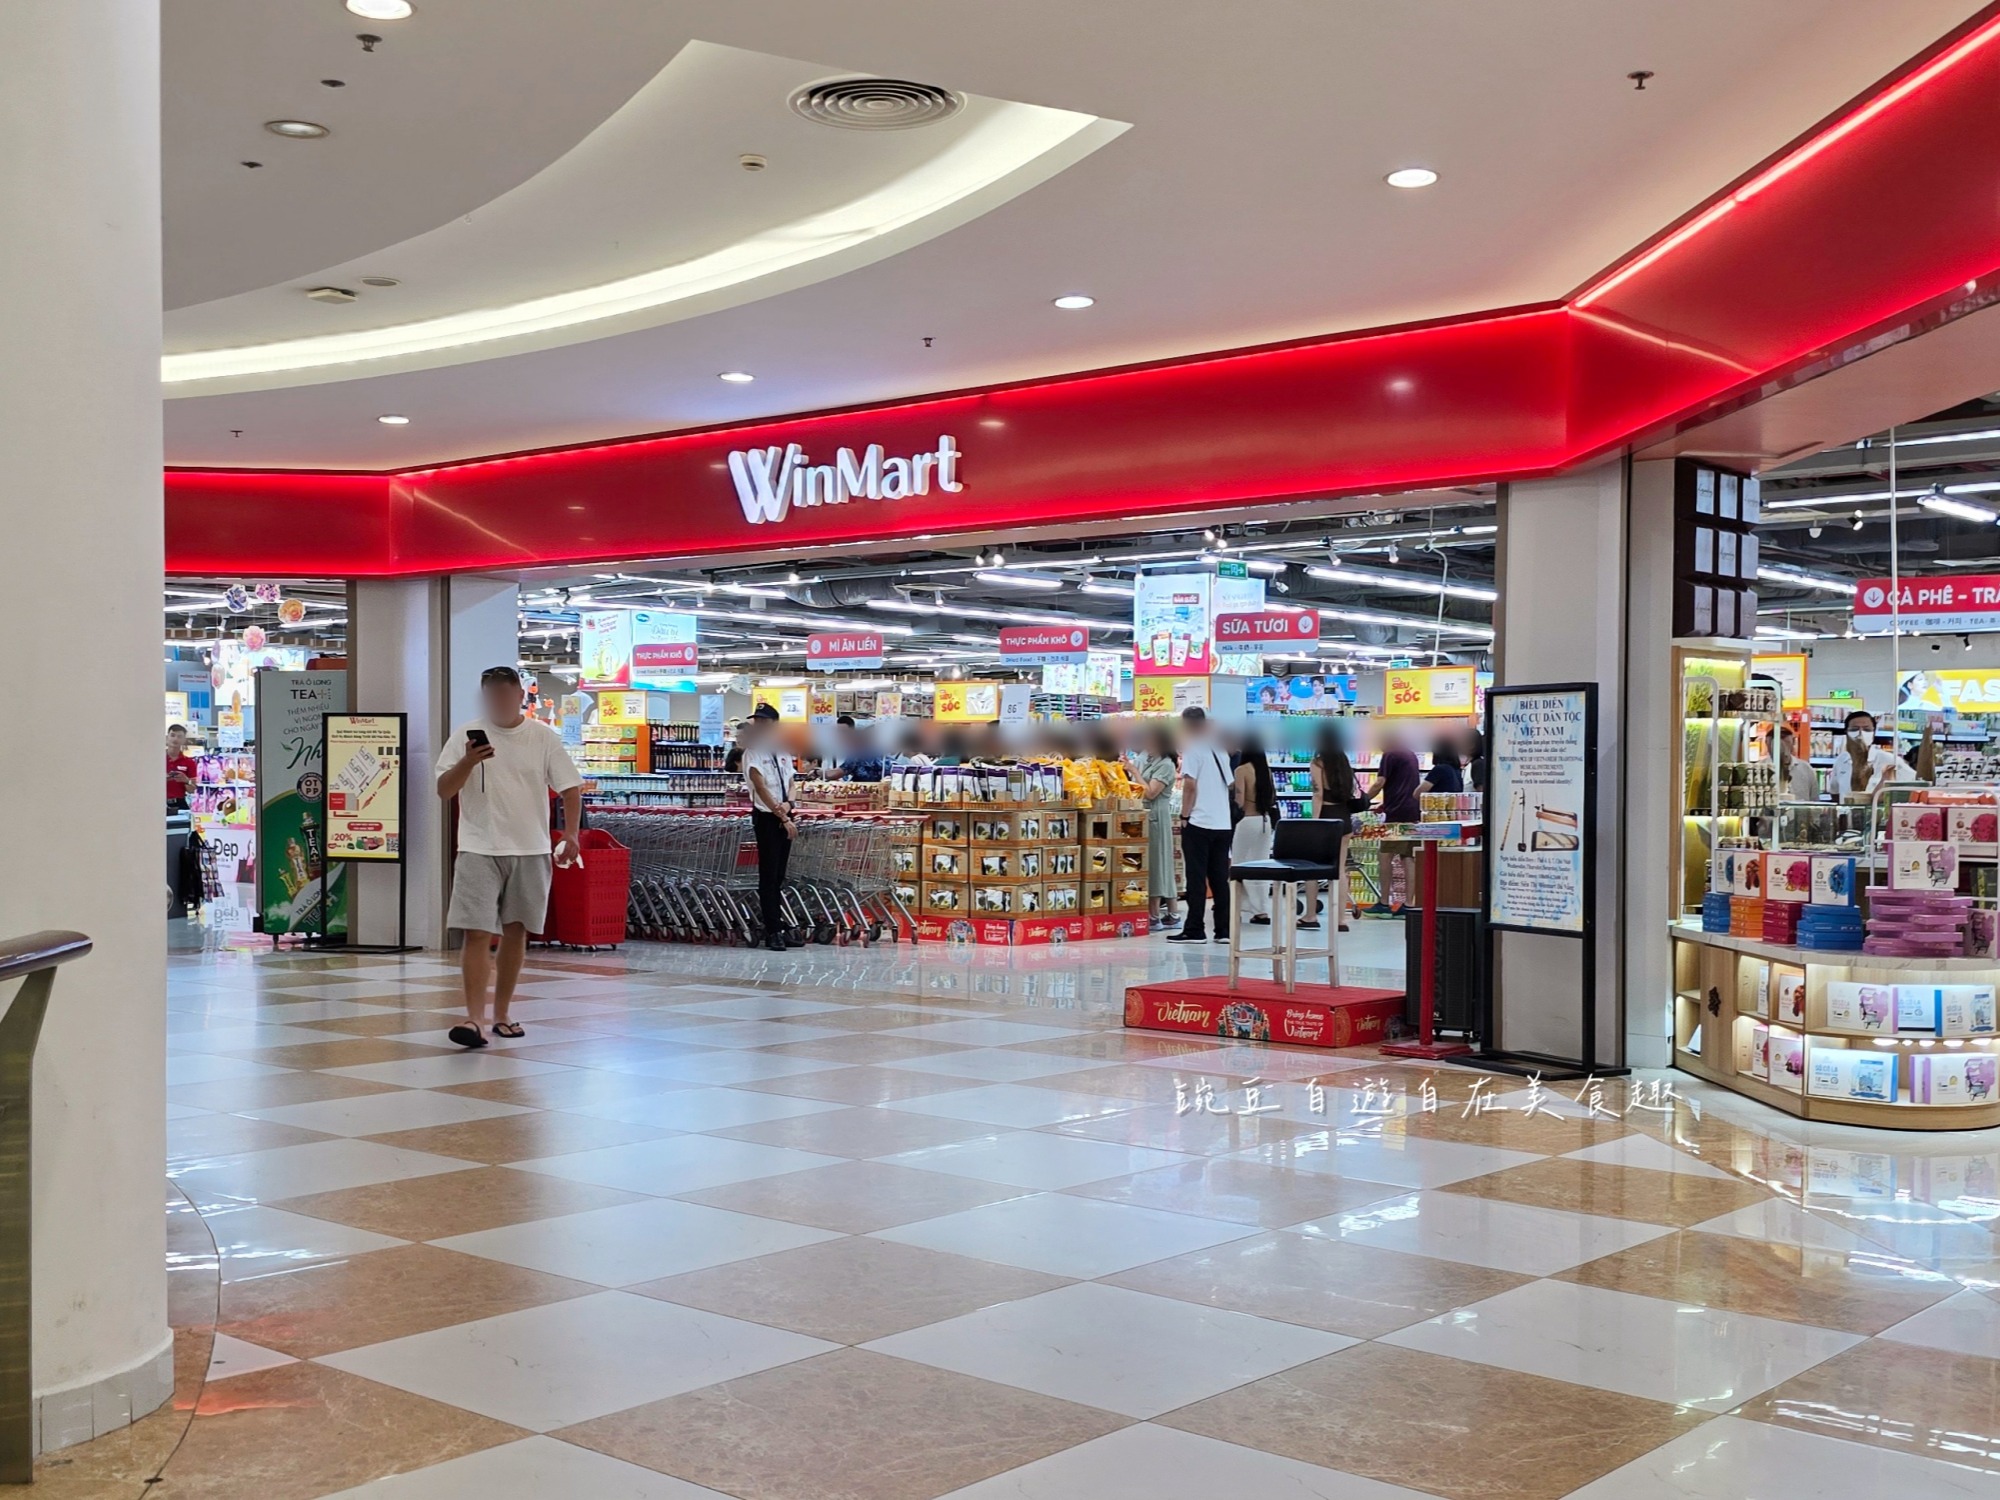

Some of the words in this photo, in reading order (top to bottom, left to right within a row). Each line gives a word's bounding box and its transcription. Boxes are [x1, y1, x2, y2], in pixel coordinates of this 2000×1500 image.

[727, 434, 963, 524] WinMart
[1887, 586, 1914, 606] CÀ
[1918, 584, 1954, 606] PHÊ
[1222, 619, 1251, 634] SỮA
[1254, 618, 1288, 633] TƯƠI
[829, 638, 840, 652] MÌ
[841, 638, 855, 652] ĂN
[1005, 637, 1026, 647] THỰC
[1050, 634, 1067, 644] KHÔ
[1142, 695, 1165, 708] SỐC
[1394, 687, 1421, 704] SỐC
[814, 703, 832, 714] SỐC
[941, 700, 961, 712] SỐC
[1502, 713, 1527, 725] NHẠC
[1528, 713, 1542, 725] CỤ
[1543, 710, 1561, 722] DÂN
[1563, 710, 1582, 724] TỘC
[283, 727, 299, 735] CHO
[1520, 726, 1542, 738] VIỆT
[1543, 726, 1564, 736] NAM
[286, 737, 323, 770] Nh
[304, 779, 318, 787] OT
[334, 833, 353, 841] 20%
[311, 889, 322, 901] LON
[1157, 1000, 1211, 1028] Vietnam
[1286, 1008, 1305, 1020] Bring
[1305, 1009, 1324, 1020] home
[1284, 1018, 1323, 1041] Vietnam!
